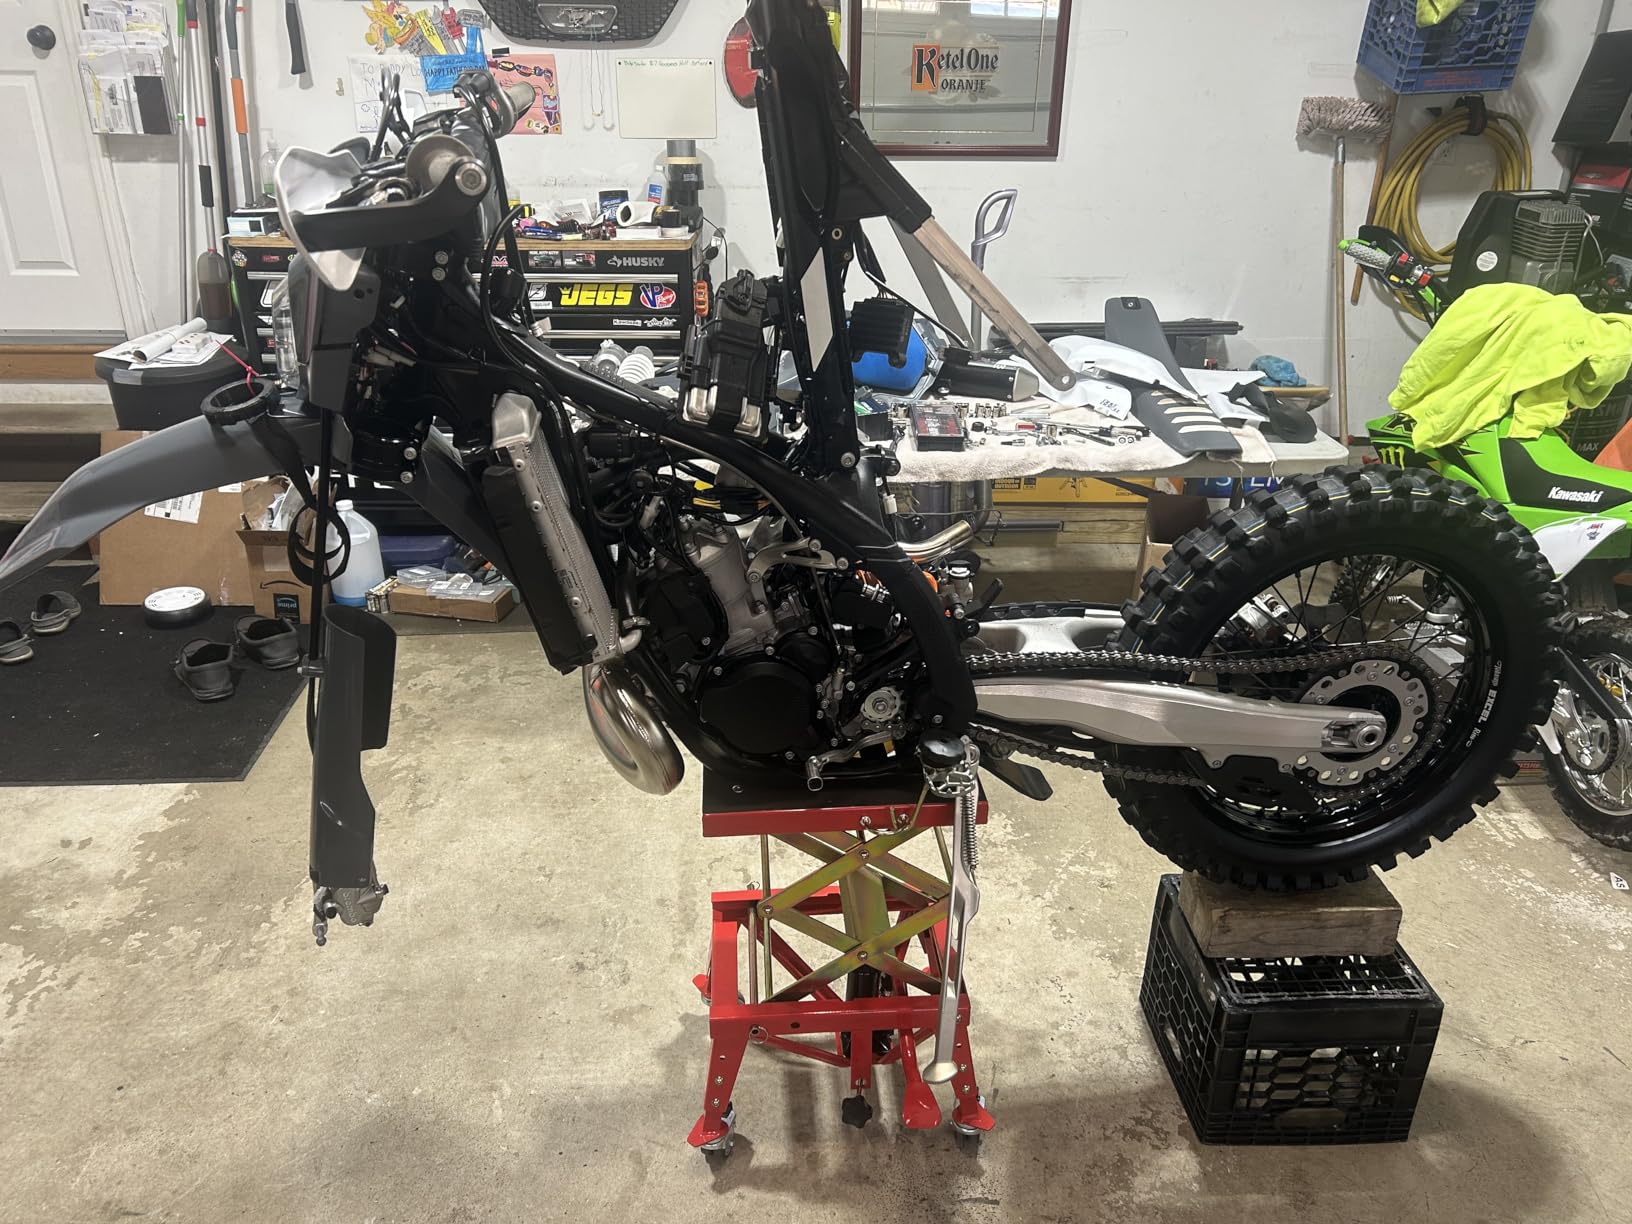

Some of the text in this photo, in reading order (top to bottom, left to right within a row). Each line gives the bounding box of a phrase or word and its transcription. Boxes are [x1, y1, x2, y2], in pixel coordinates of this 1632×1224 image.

[380, 63, 406, 74] DDDY
[914, 47, 999, 88] Ketel One
[941, 78, 987, 92] ORANJE
[622, 257, 665, 267] HUSKY
[560, 283, 634, 306] JEGS
[639, 283, 664, 308] VP
[1547, 486, 1605, 503] Kawasaki
[1478, 689, 1498, 723] EXCEL
